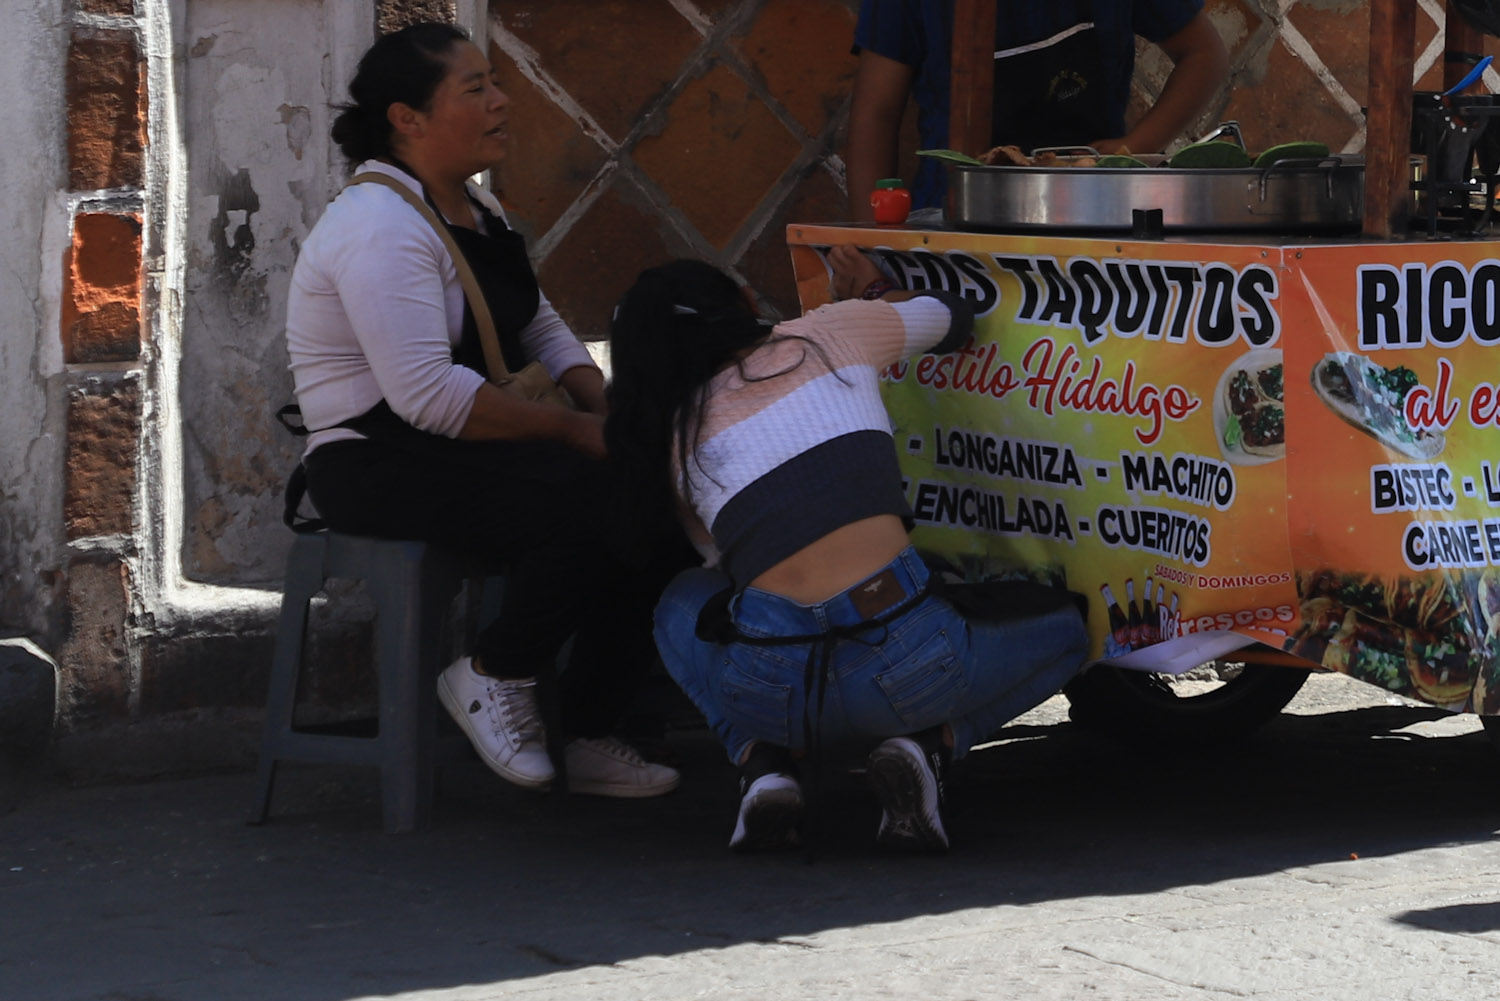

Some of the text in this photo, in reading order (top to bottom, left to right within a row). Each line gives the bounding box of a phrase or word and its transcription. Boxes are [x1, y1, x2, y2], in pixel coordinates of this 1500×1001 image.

[881, 249, 1277, 346] COS TAQUITOS
[917, 336, 1199, 444] estilo Hidalgo
[1405, 360, 1456, 427] al
[936, 428, 1082, 487] LONGANIZA
[1122, 455, 1233, 506] MACHITO
[1373, 467, 1452, 508] BISTEC
[914, 484, 1073, 541] ENCHILADA
[1098, 509, 1210, 564] CUERITOS
[1405, 524, 1482, 566] CARNE
[1154, 564, 1291, 589] SABADOS Y DOMINGOS
[1159, 603, 1295, 642] Refrescos
